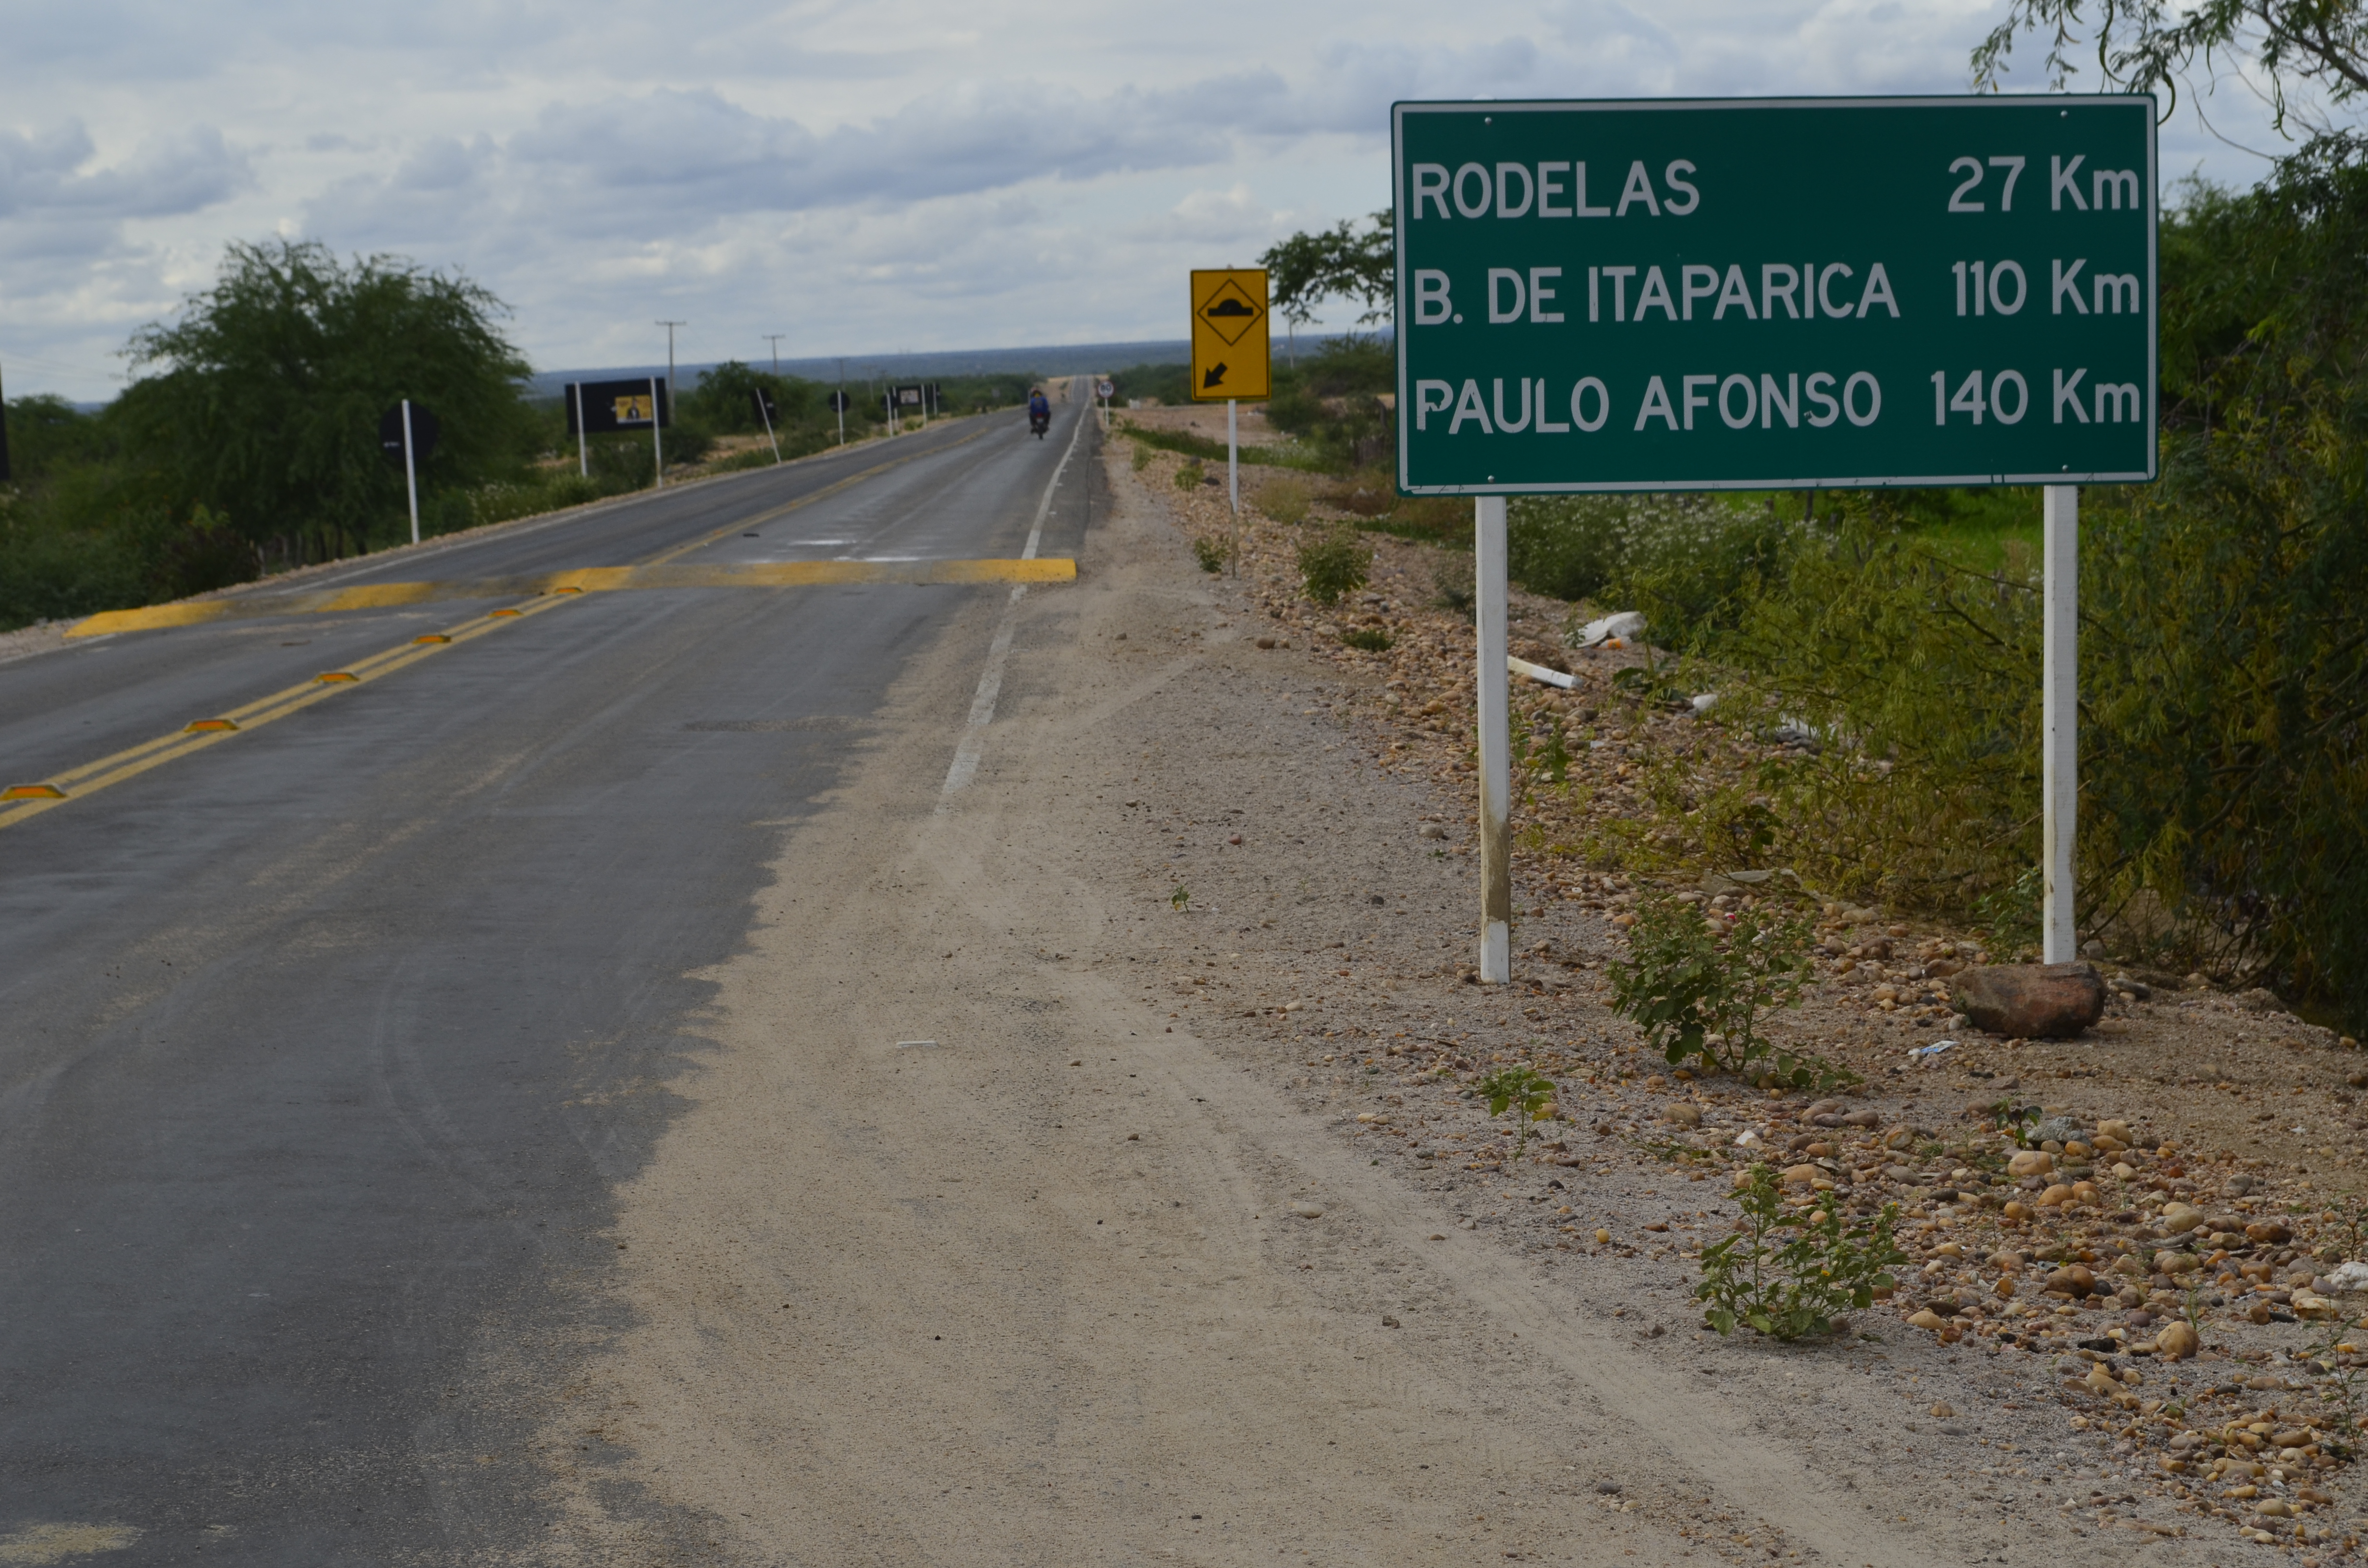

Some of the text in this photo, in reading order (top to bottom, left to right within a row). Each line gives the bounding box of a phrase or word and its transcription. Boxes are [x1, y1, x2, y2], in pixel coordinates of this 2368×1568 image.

[1413, 156, 2138, 219] RODELAS 27 Km
[1415, 260, 2139, 324] B. DE ITAPARICA 110 Km
[1416, 369, 2139, 434] PAULO AFONSO 140 Km
